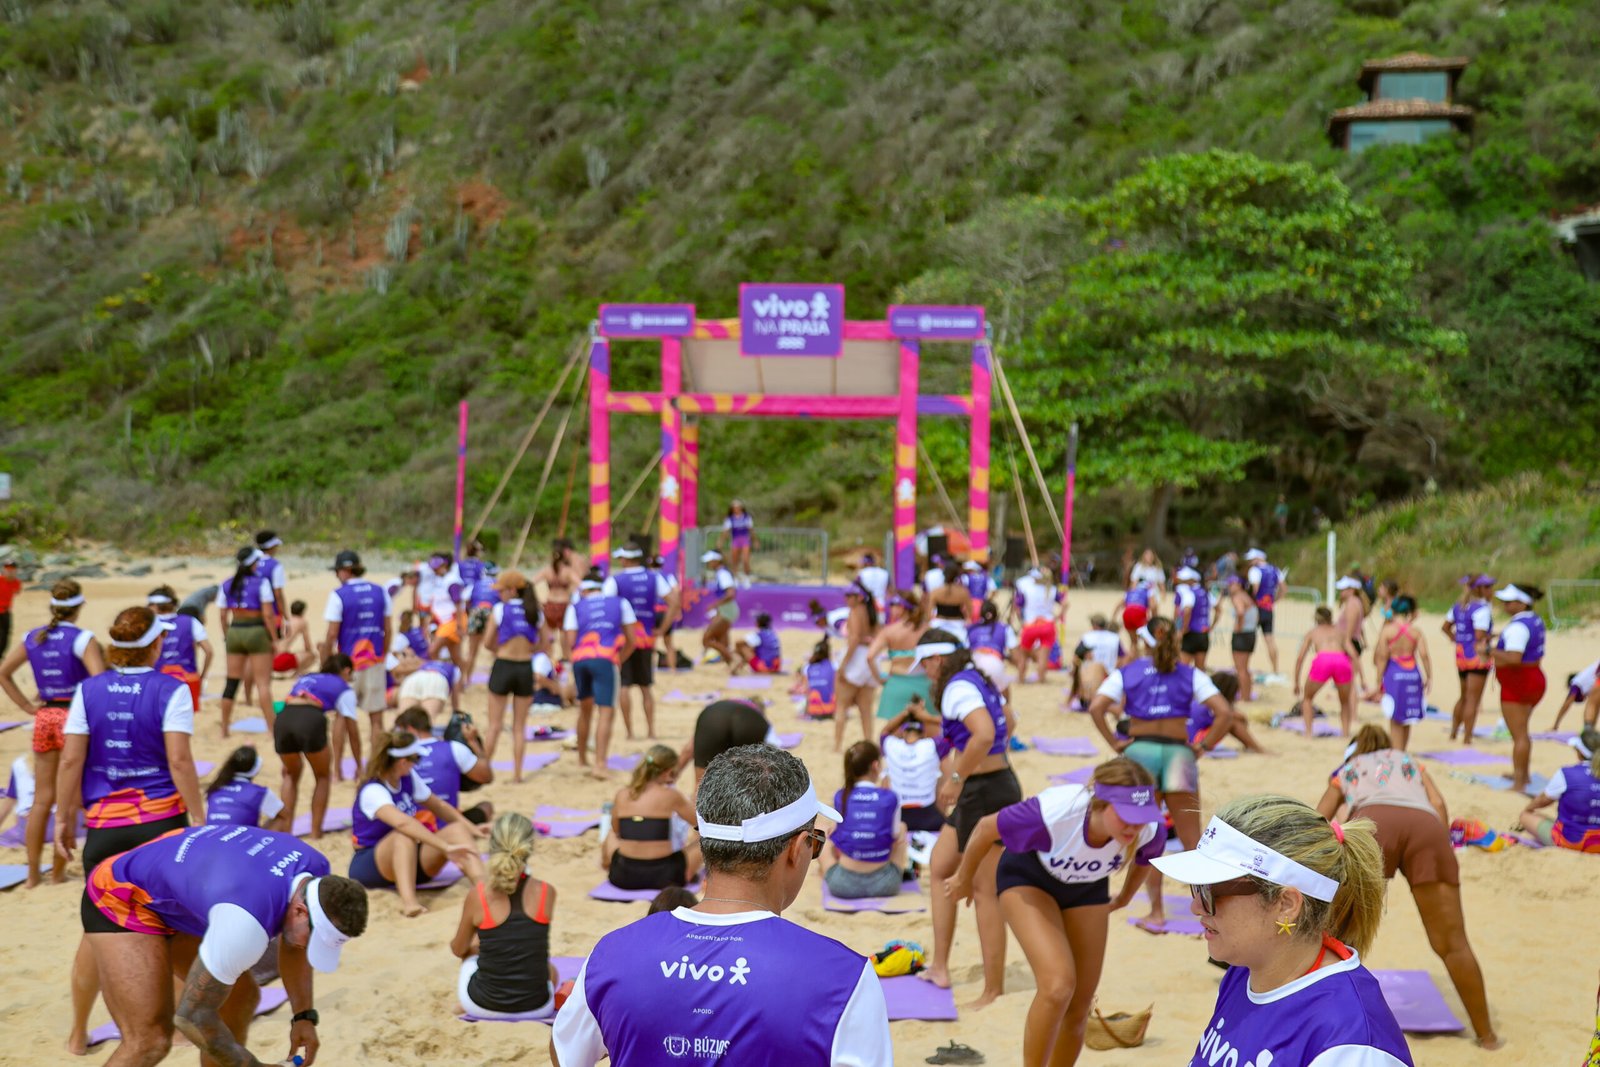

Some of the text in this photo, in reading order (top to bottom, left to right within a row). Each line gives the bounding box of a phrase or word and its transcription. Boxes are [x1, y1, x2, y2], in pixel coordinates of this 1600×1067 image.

[752, 293, 810, 318] vivo
[107, 682, 132, 693] vivo
[1050, 857, 1102, 872] vivo
[660, 955, 725, 982] vivo
[694, 1036, 730, 1054] BÚZIOS
